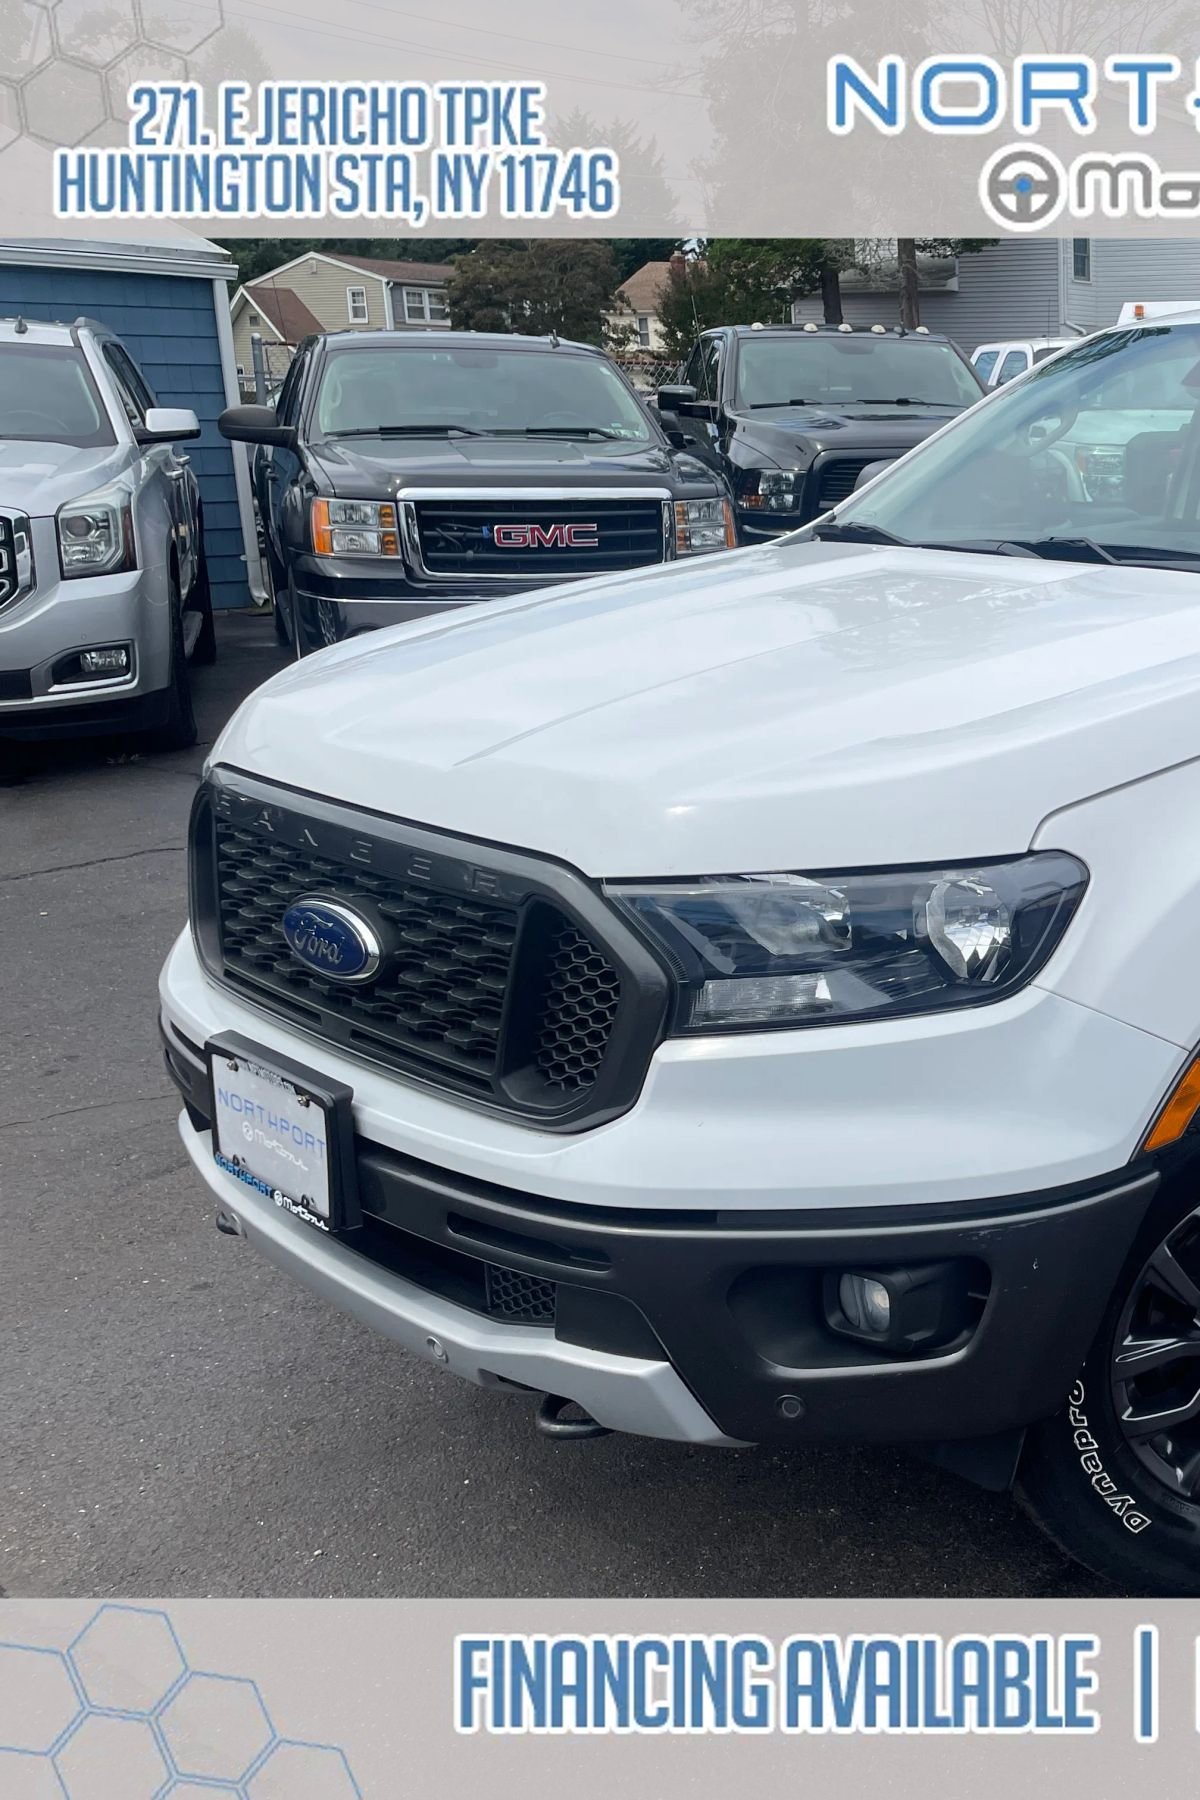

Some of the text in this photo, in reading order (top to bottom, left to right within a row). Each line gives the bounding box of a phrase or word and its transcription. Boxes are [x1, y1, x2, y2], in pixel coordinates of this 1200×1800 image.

[493, 523, 599, 548] GMC
[293, 911, 346, 966] Ford
[217, 1086, 327, 1160] NORTHPORT
[281, 1195, 330, 1232] Motors
[1068, 1379, 1152, 1534] Dynapro
